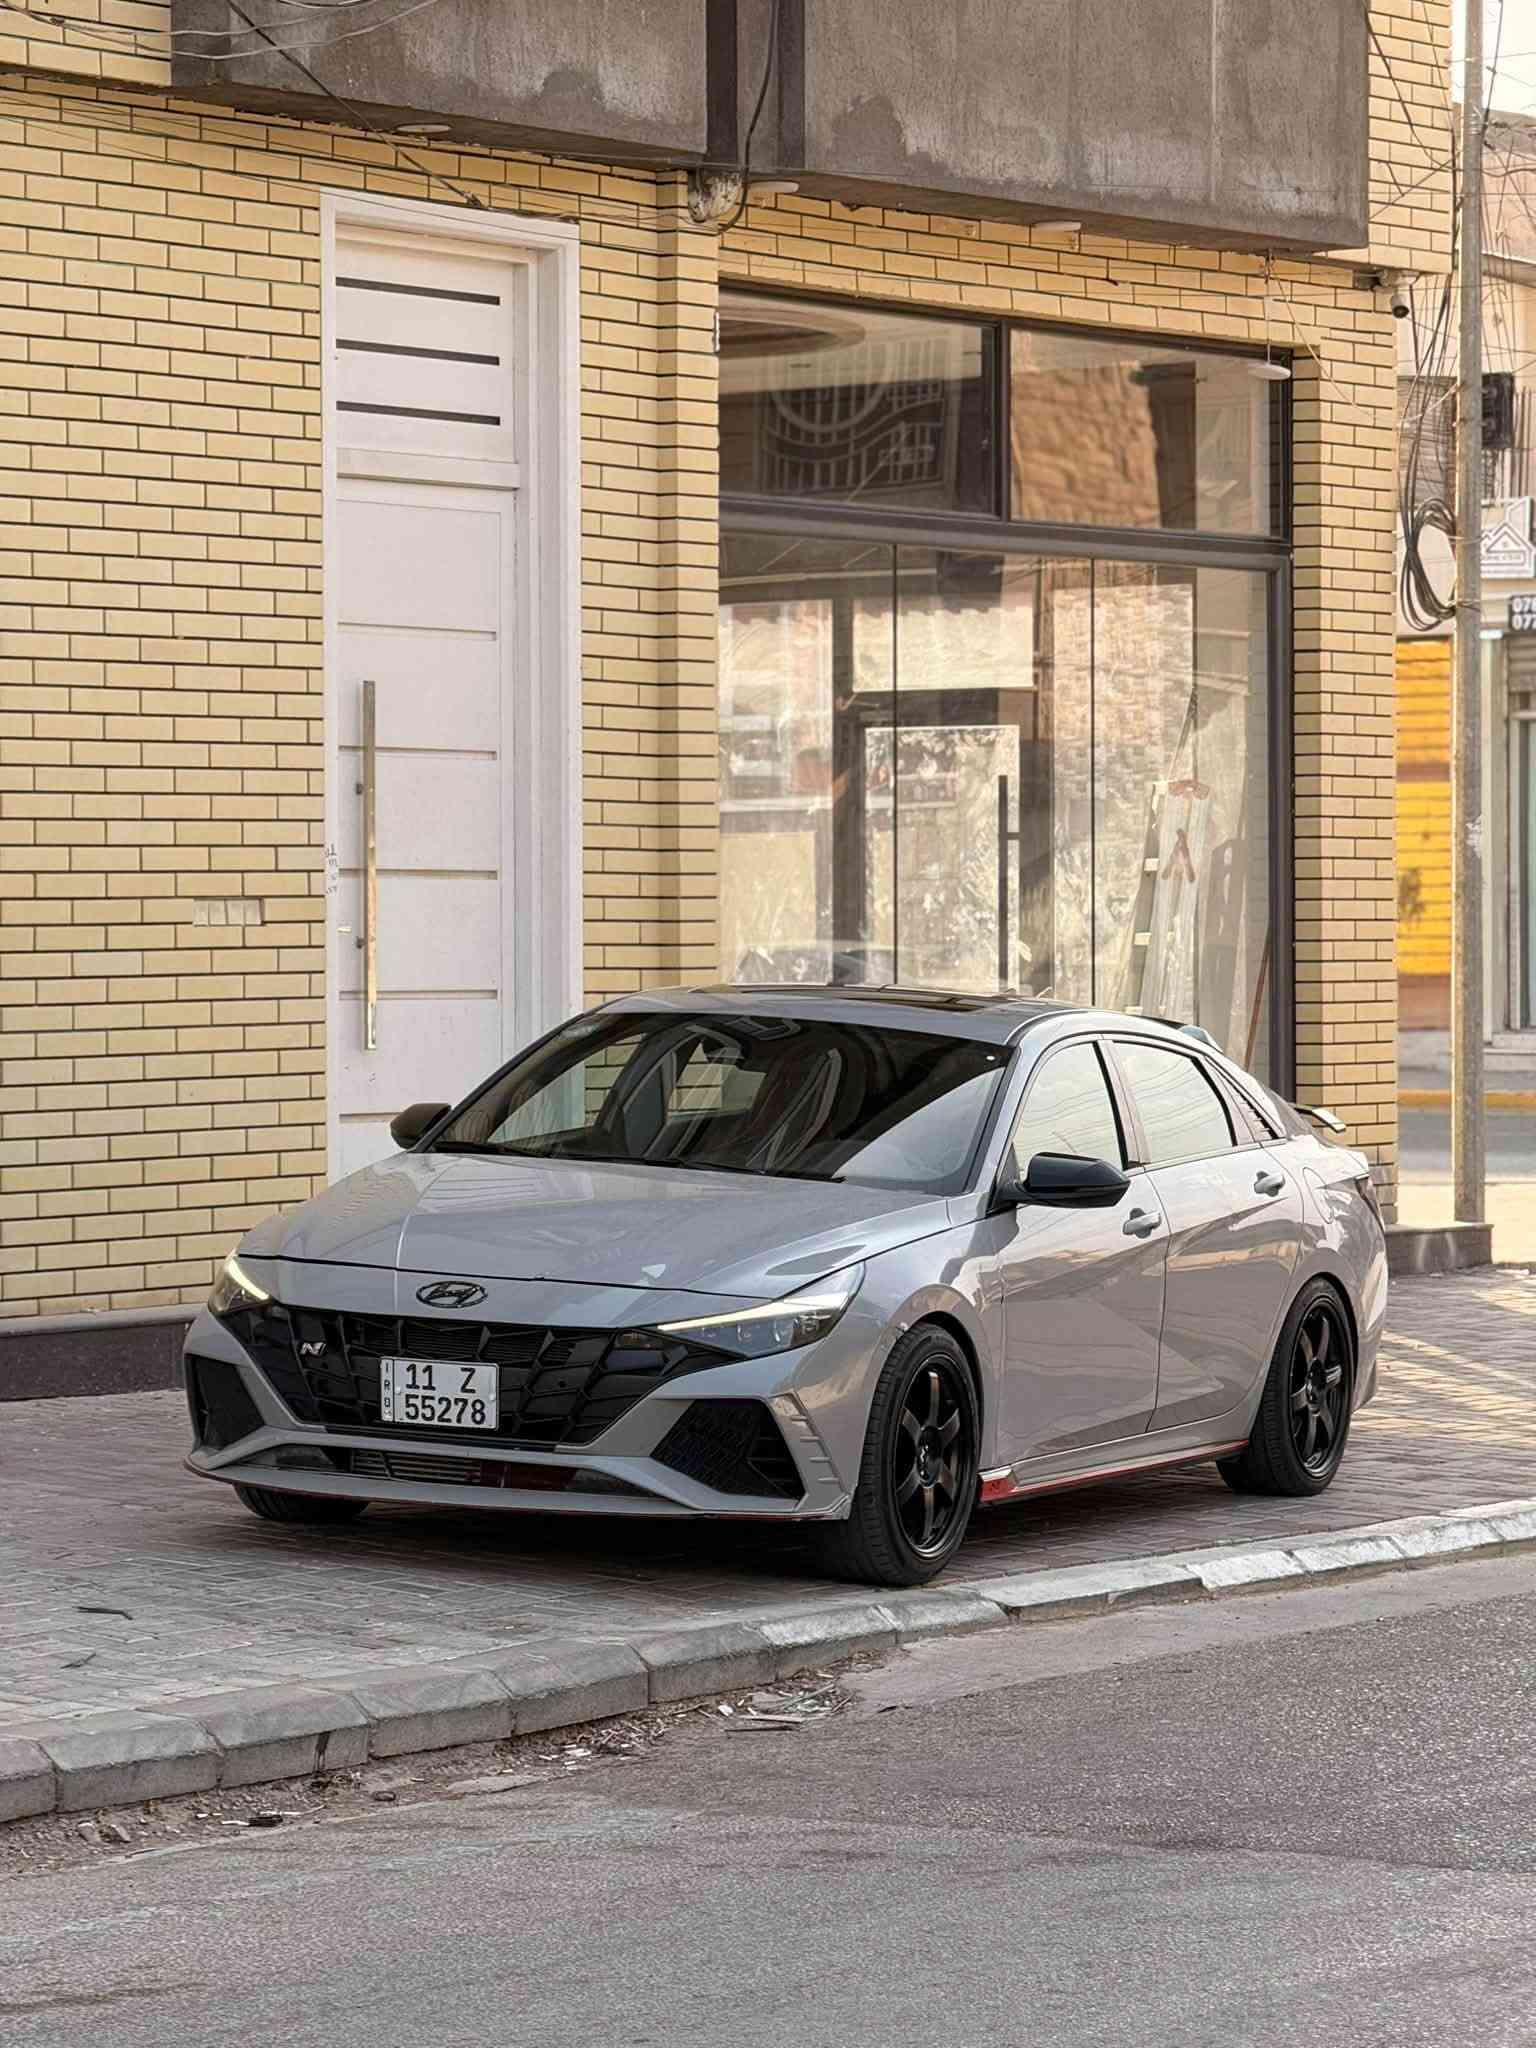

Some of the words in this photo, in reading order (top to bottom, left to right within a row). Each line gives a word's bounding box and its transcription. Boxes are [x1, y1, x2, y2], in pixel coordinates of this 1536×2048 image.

[406, 1363, 436, 1391] 11
[460, 1367, 476, 1393] Z
[405, 1394, 486, 1425] 55278
